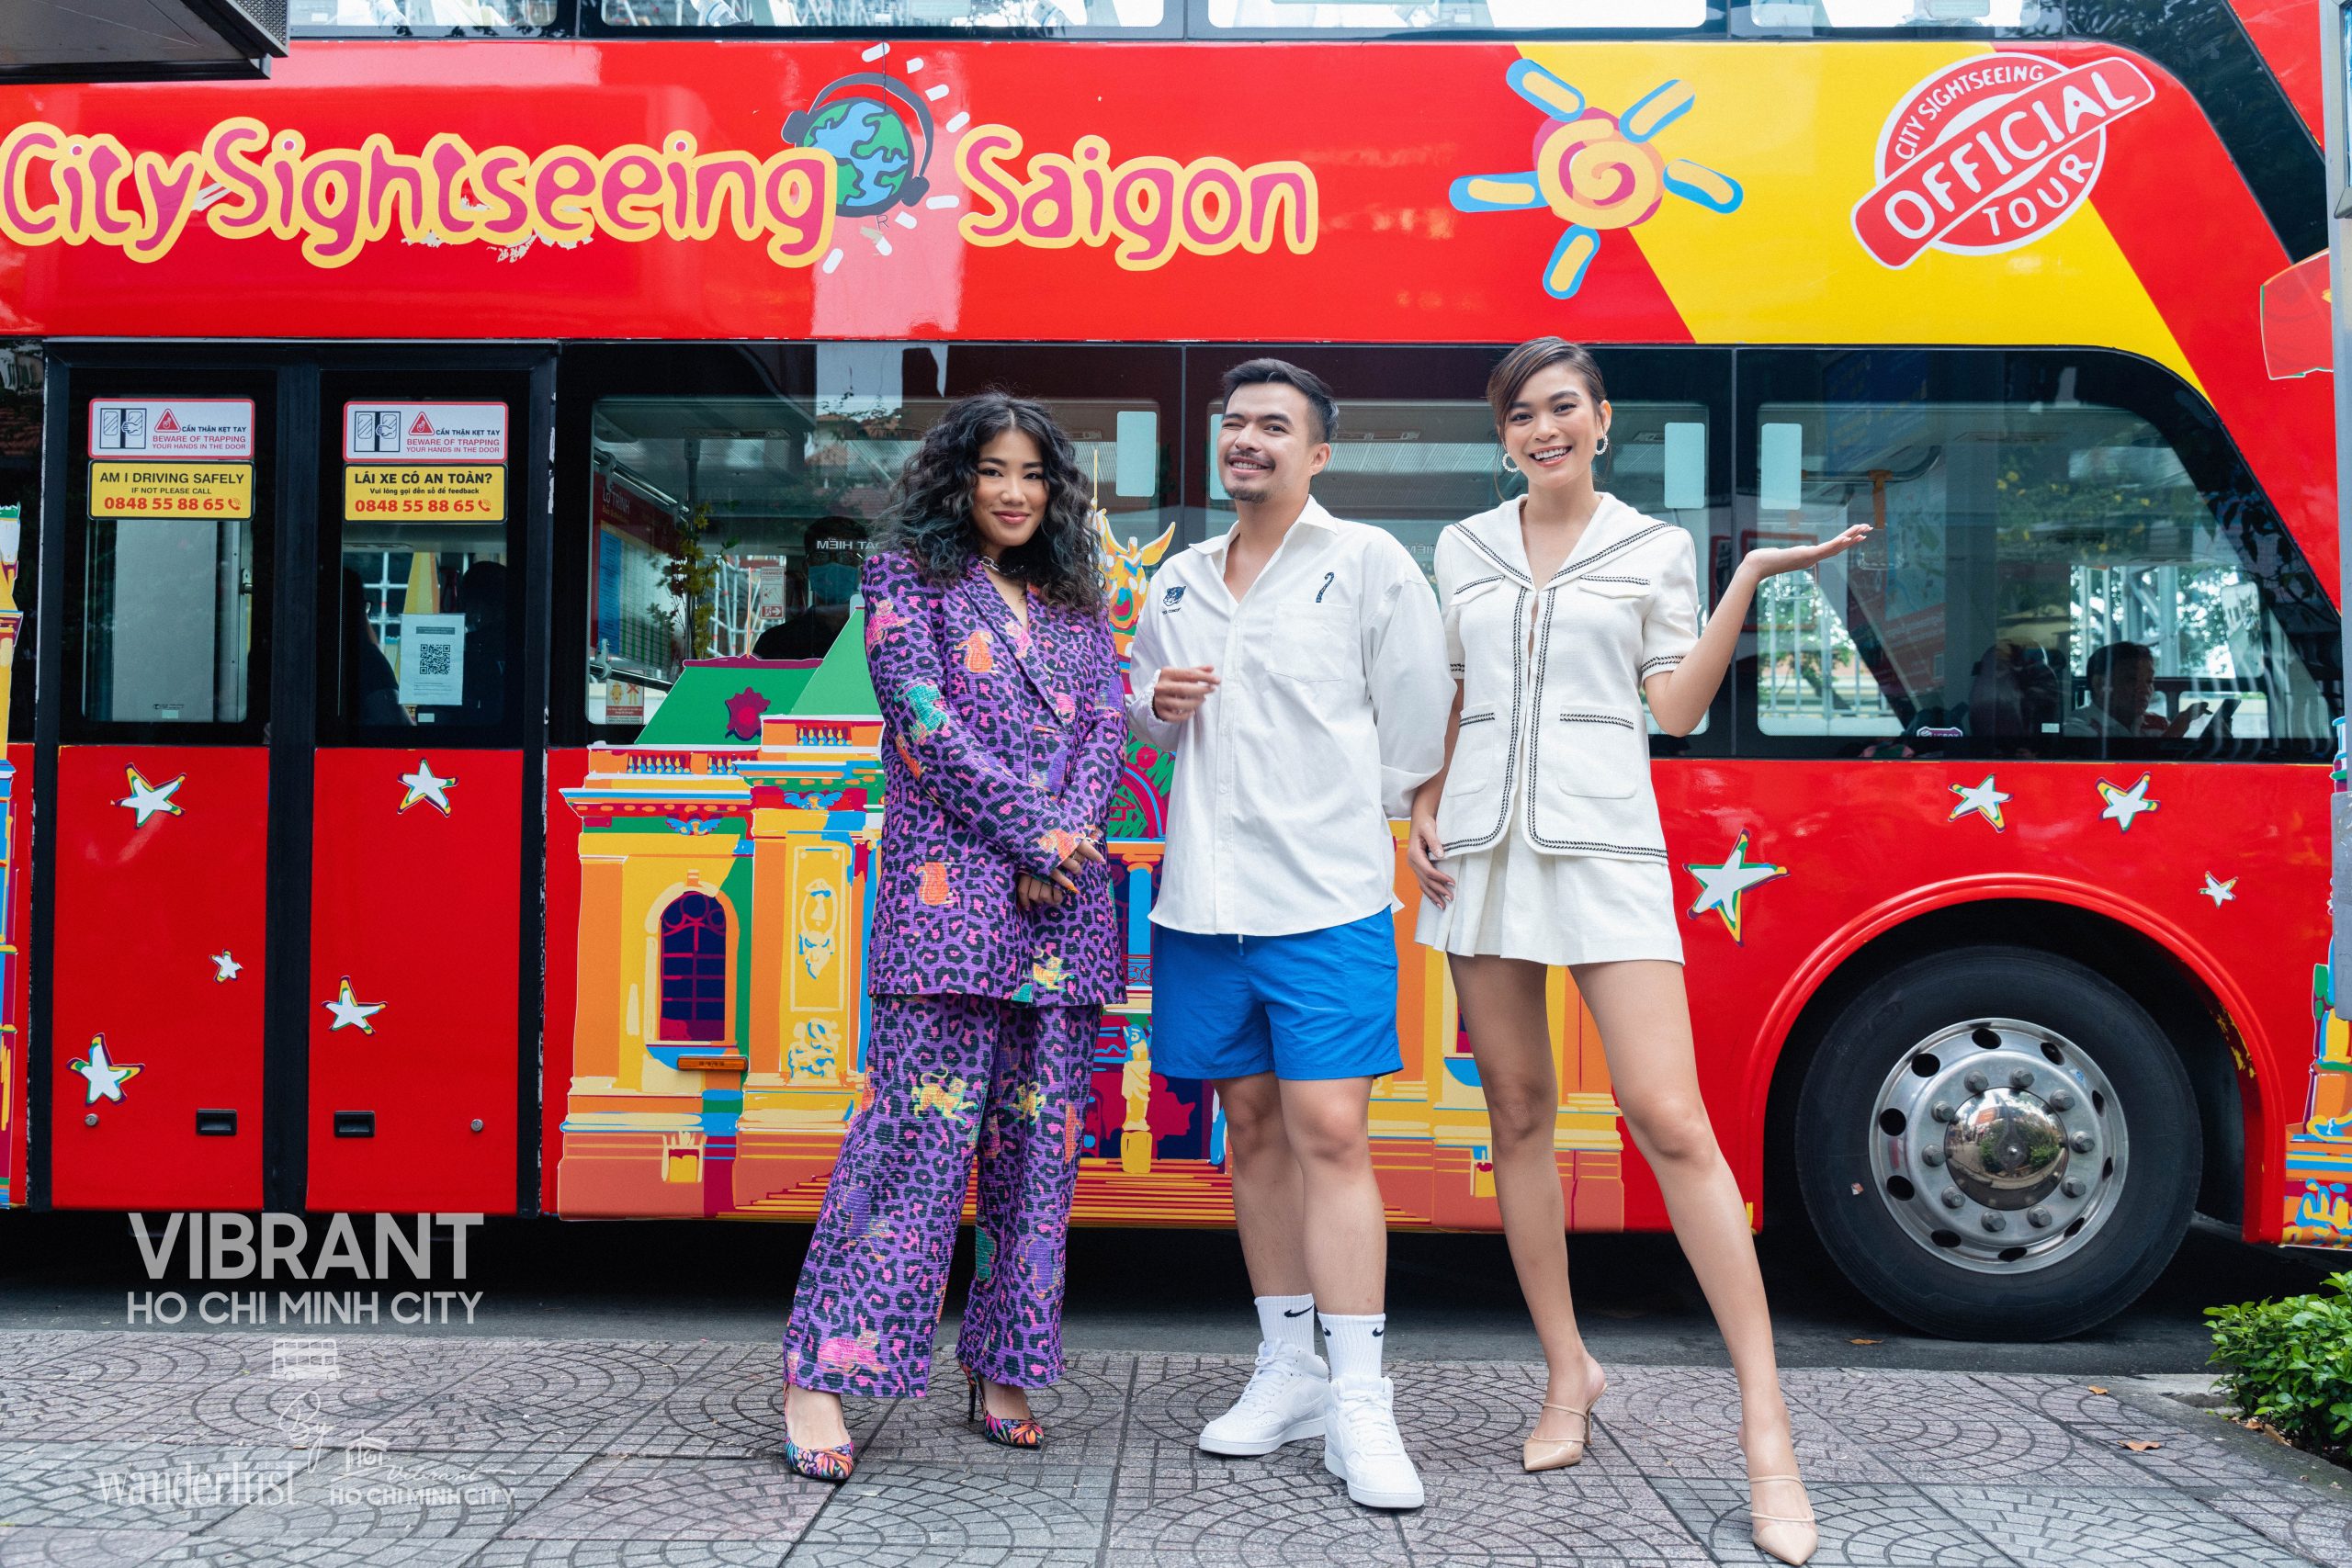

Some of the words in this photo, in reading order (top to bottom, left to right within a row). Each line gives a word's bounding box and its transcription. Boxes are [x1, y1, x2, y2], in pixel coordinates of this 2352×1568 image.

[1894, 115, 1926, 160] CITY
[1919, 64, 2044, 120] SIGHTSEEING
[1884, 72, 2136, 240] OFFICIAL
[956, 125, 1317, 270] Saigon
[1982, 153, 2094, 237] TOUR
[218, 426, 231, 434] KẸT
[471, 429, 484, 437] KẸT
[99, 472, 120, 483] AM
[124, 472, 129, 483] I
[132, 472, 189, 484] DRIVING
[193, 473, 244, 484] SAFELY
[355, 470, 376, 484] LÁI
[379, 473, 397, 484] XE
[401, 470, 420, 484] CÓ
[424, 473, 443, 484] AN
[447, 470, 492, 484] TOÀN?
[383, 487, 398, 495] lòng
[400, 488, 411, 496] gọi
[427, 486, 435, 494] số
[104, 496, 148, 510] 0848
[152, 497, 173, 511] 55
[177, 497, 199, 511] 88
[202, 498, 224, 511] 65
[355, 500, 398, 512] 0848
[402, 500, 424, 512] 55
[427, 500, 449, 512] 88
[453, 500, 475, 512] 65
